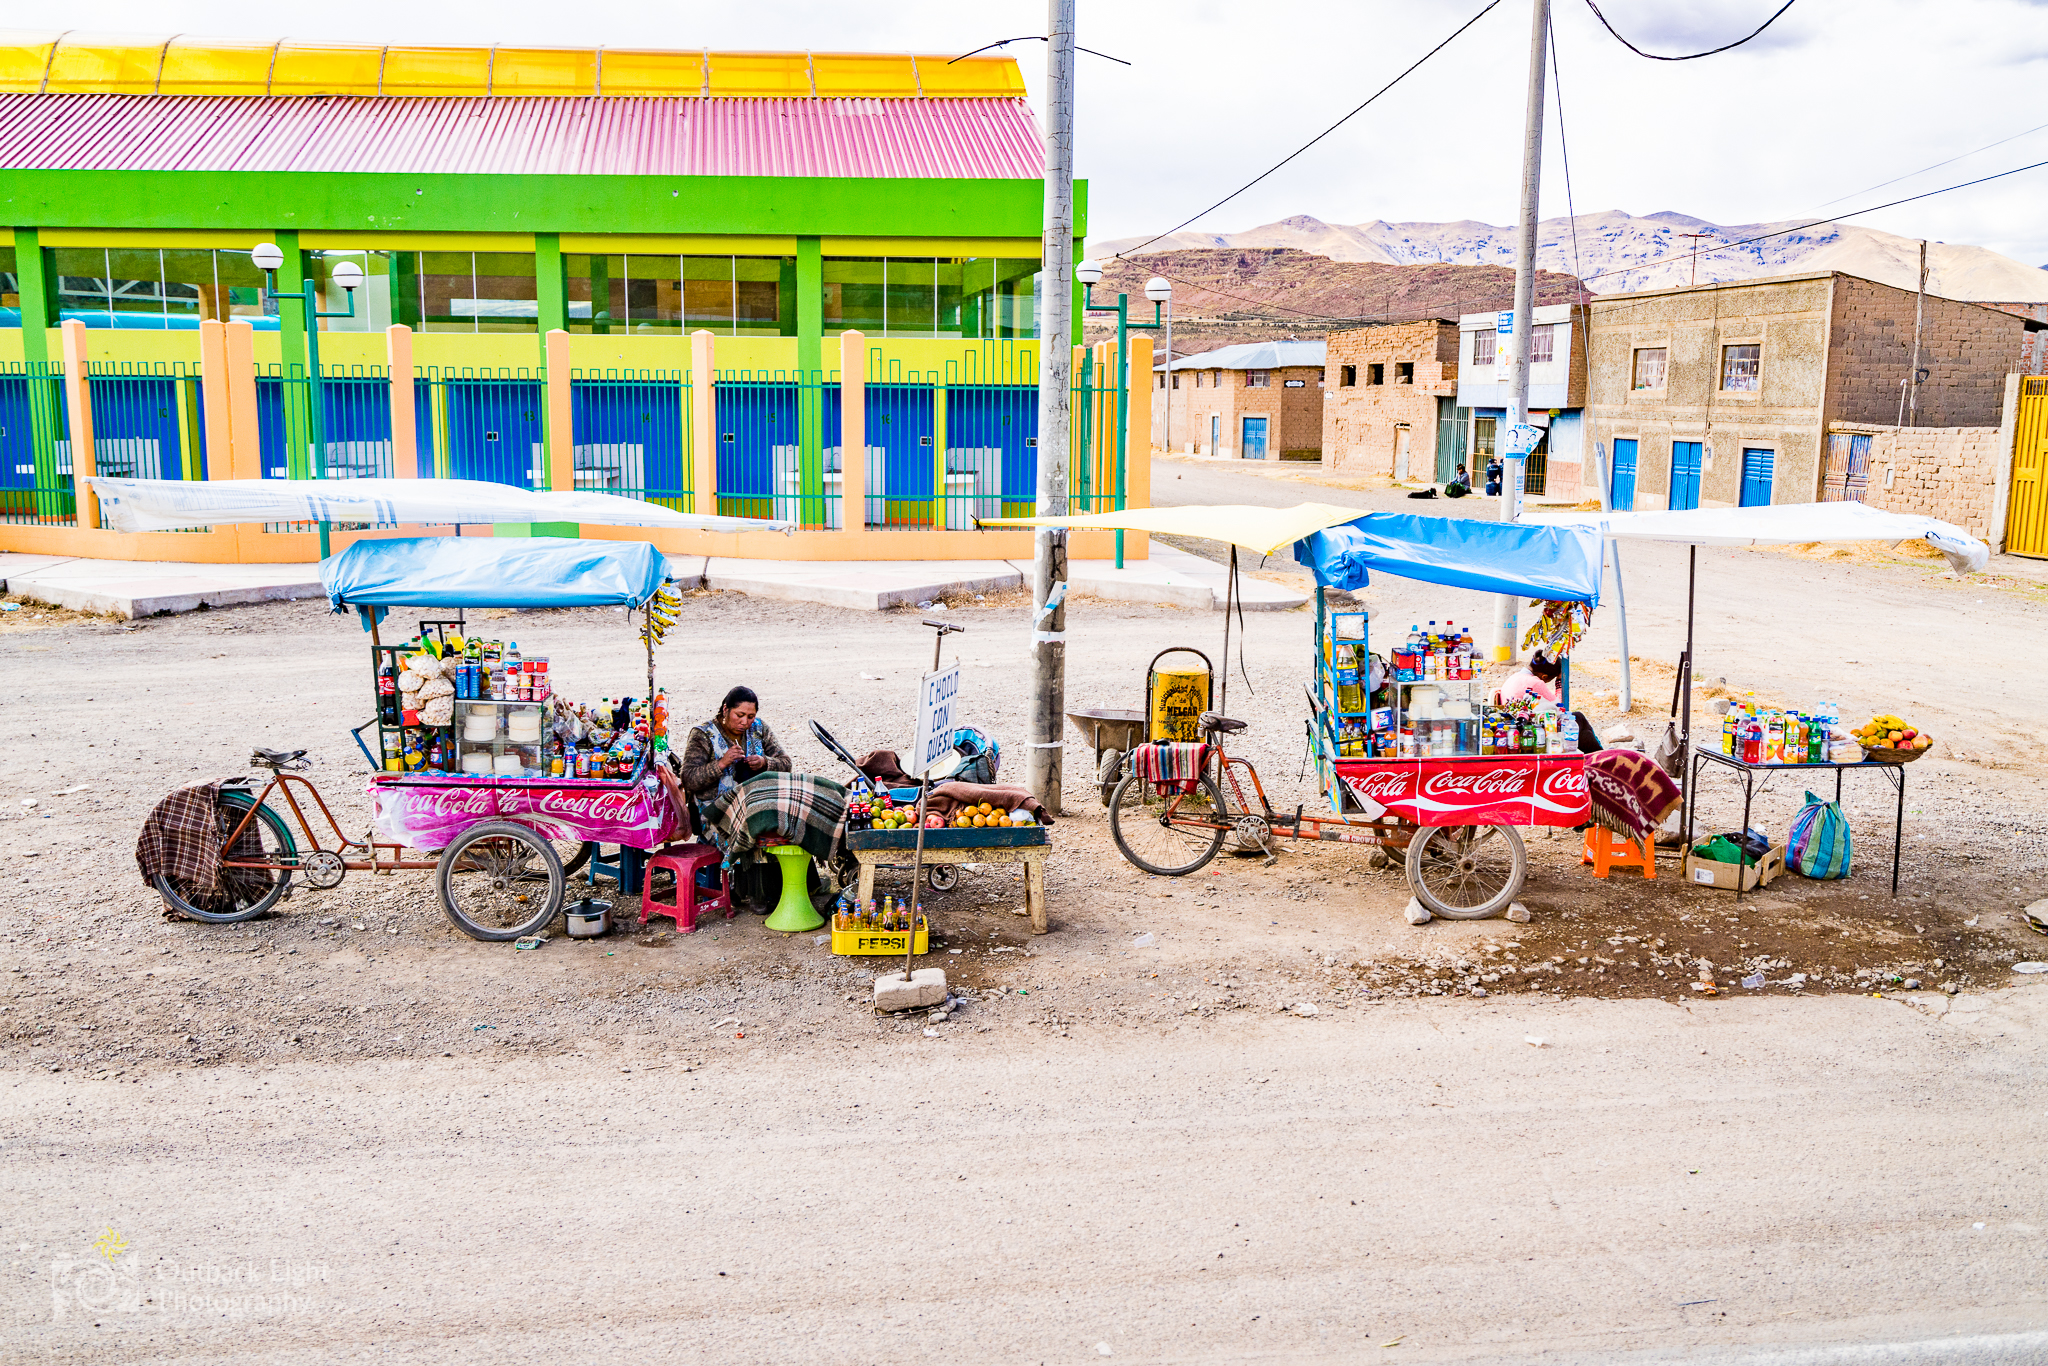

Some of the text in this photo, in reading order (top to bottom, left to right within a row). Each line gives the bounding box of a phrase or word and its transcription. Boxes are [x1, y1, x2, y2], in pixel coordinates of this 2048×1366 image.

[929, 670, 959, 707] CHOCLO
[932, 703, 950, 729] CON
[1166, 706, 1198, 716] MELGAR
[926, 728, 953, 763] QUESO
[1424, 768, 1534, 795] Coca-Cola
[539, 789, 639, 823] Coca-Cola
[858, 937, 906, 950] PEPSI
